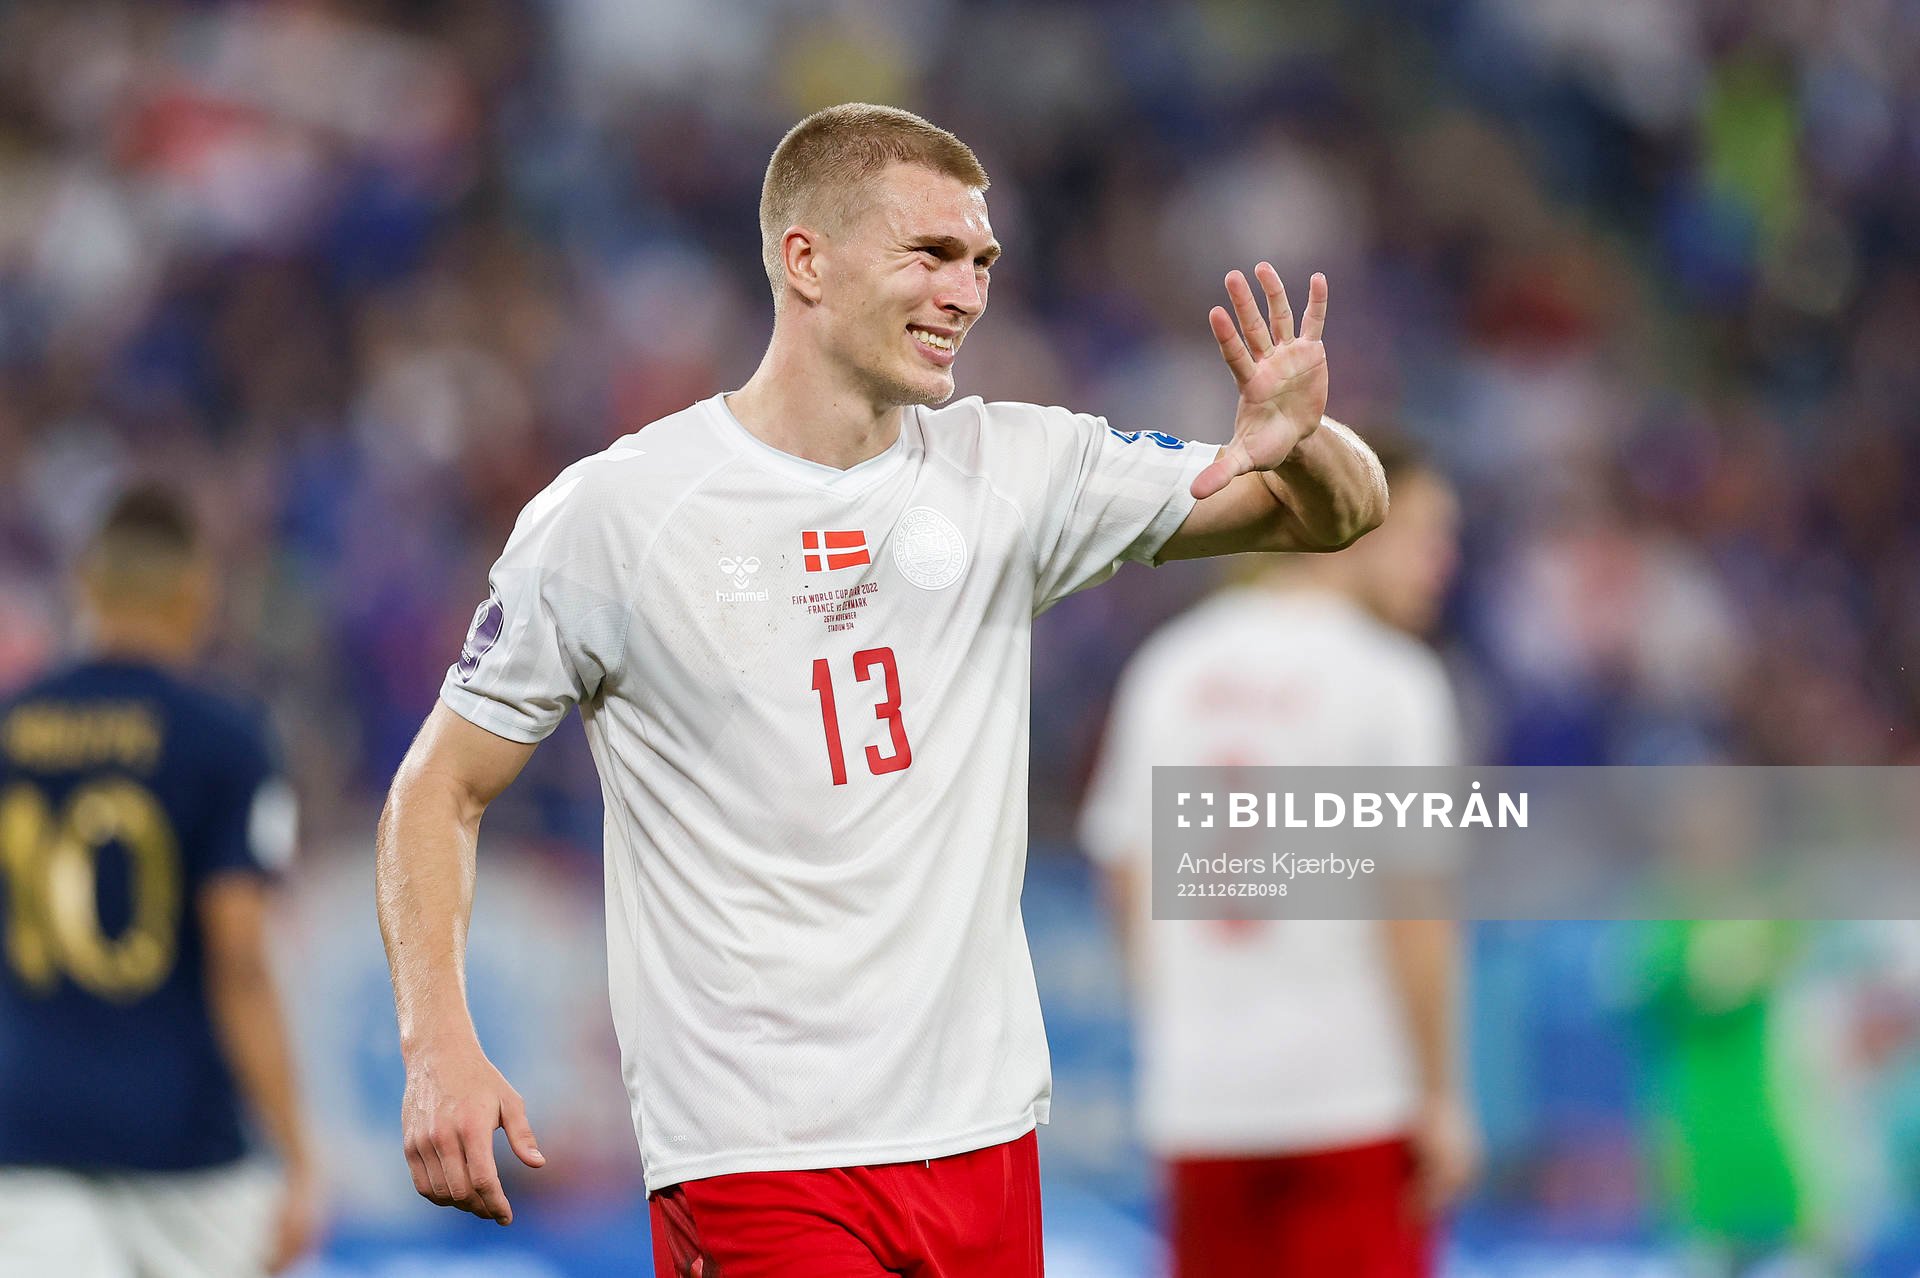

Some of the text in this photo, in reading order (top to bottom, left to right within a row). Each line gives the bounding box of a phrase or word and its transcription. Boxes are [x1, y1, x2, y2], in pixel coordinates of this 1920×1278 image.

[716, 588, 769, 602] hummel
[792, 595, 808, 605] FIFA
[809, 591, 833, 603] WORLD
[835, 589, 849, 600] CUP
[861, 582, 878, 595] 2022
[808, 603, 835, 614] FRANCE
[843, 597, 868, 611] DENMARK
[828, 624, 846, 633] STADIUM
[812, 647, 912, 785] 13
[0, 780, 182, 1002] 10
